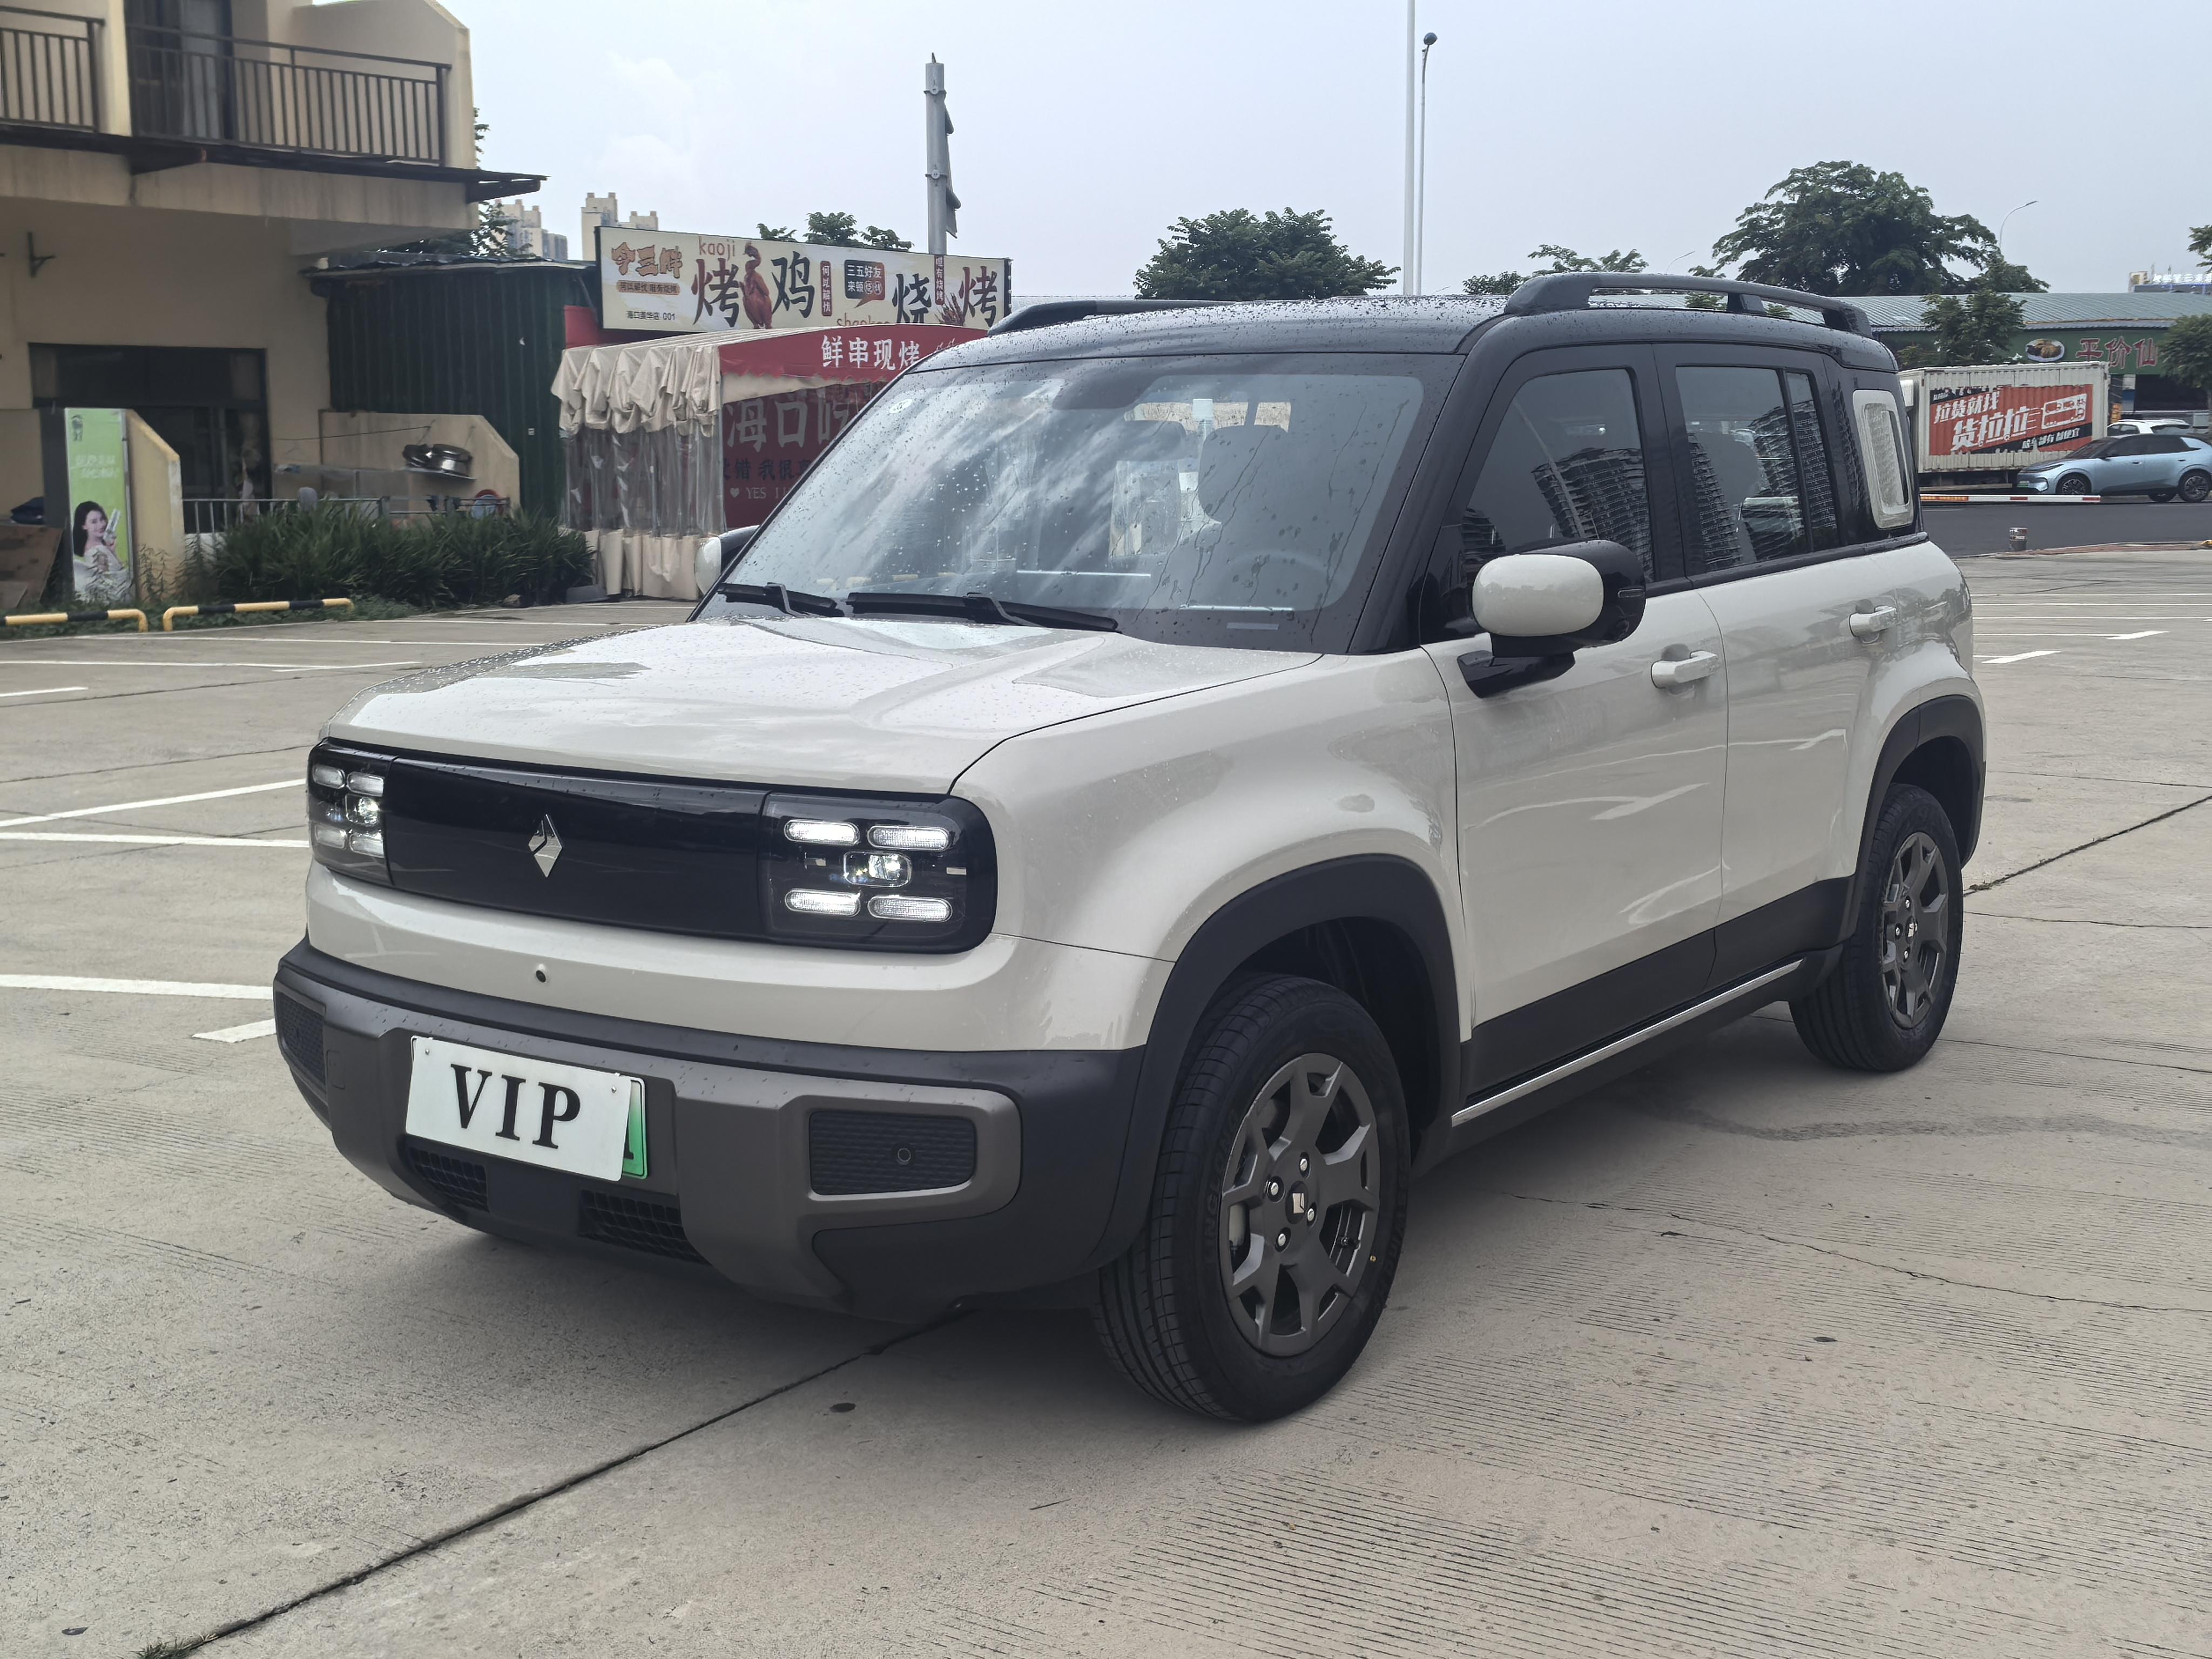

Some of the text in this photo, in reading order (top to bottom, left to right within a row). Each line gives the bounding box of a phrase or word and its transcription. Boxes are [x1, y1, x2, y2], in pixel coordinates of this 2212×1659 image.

[698, 236, 736, 261] kaoji
[691, 250, 815, 328] 烤鸡
[821, 265, 831, 312] 何以解忧
[847, 265, 882, 279] 三五好友
[891, 265, 998, 328] 烧烤
[821, 334, 920, 370] 鲜串现烤
[1933, 389, 2000, 424] 拉货就找
[1950, 406, 2031, 452] 货拉拉
[746, 487, 767, 499] YES
[450, 1063, 581, 1150] VIP
